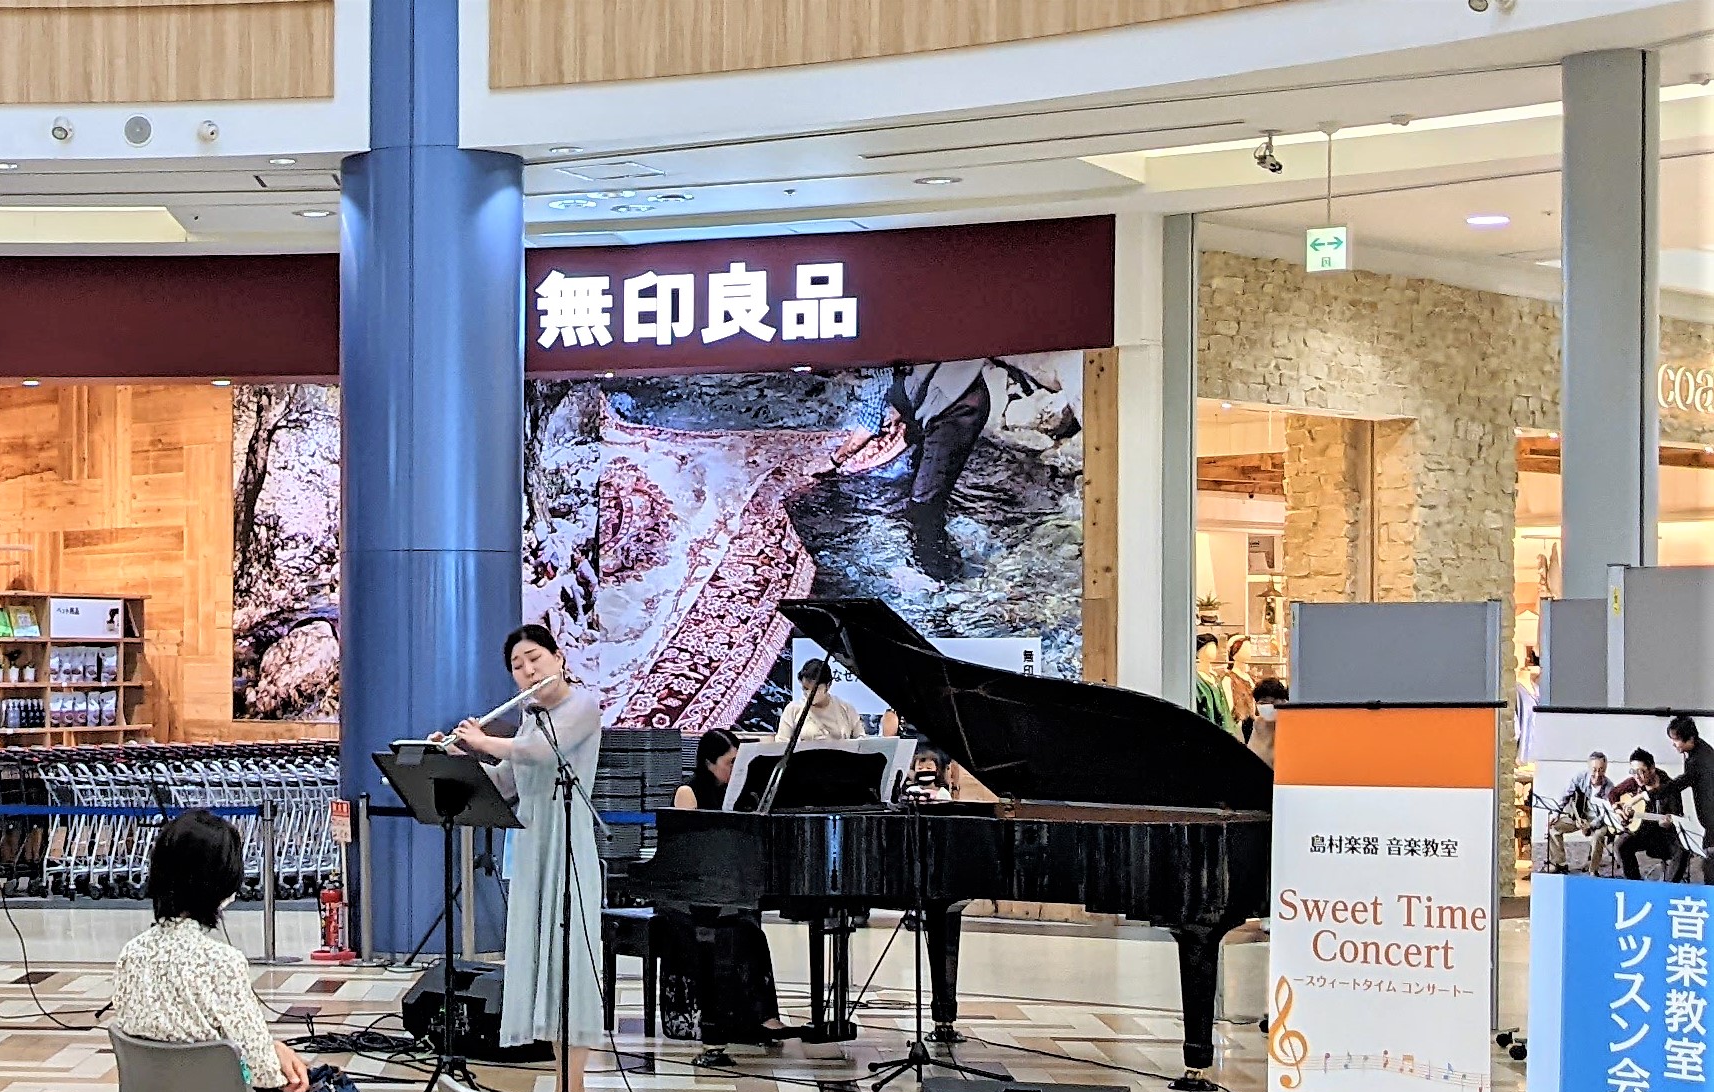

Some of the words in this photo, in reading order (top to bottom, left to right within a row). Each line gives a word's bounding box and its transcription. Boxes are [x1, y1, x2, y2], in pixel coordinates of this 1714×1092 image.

[535, 261, 859, 349] 無印良品
[1309, 834, 1380, 855] 島村楽器
[1386, 836, 1459, 859] 音楽教室
[1277, 888, 1383, 926] Sweet
[1396, 894, 1488, 932] Time
[1312, 930, 1455, 970] Concert
[1663, 895, 1711, 1083] 音楽教室
